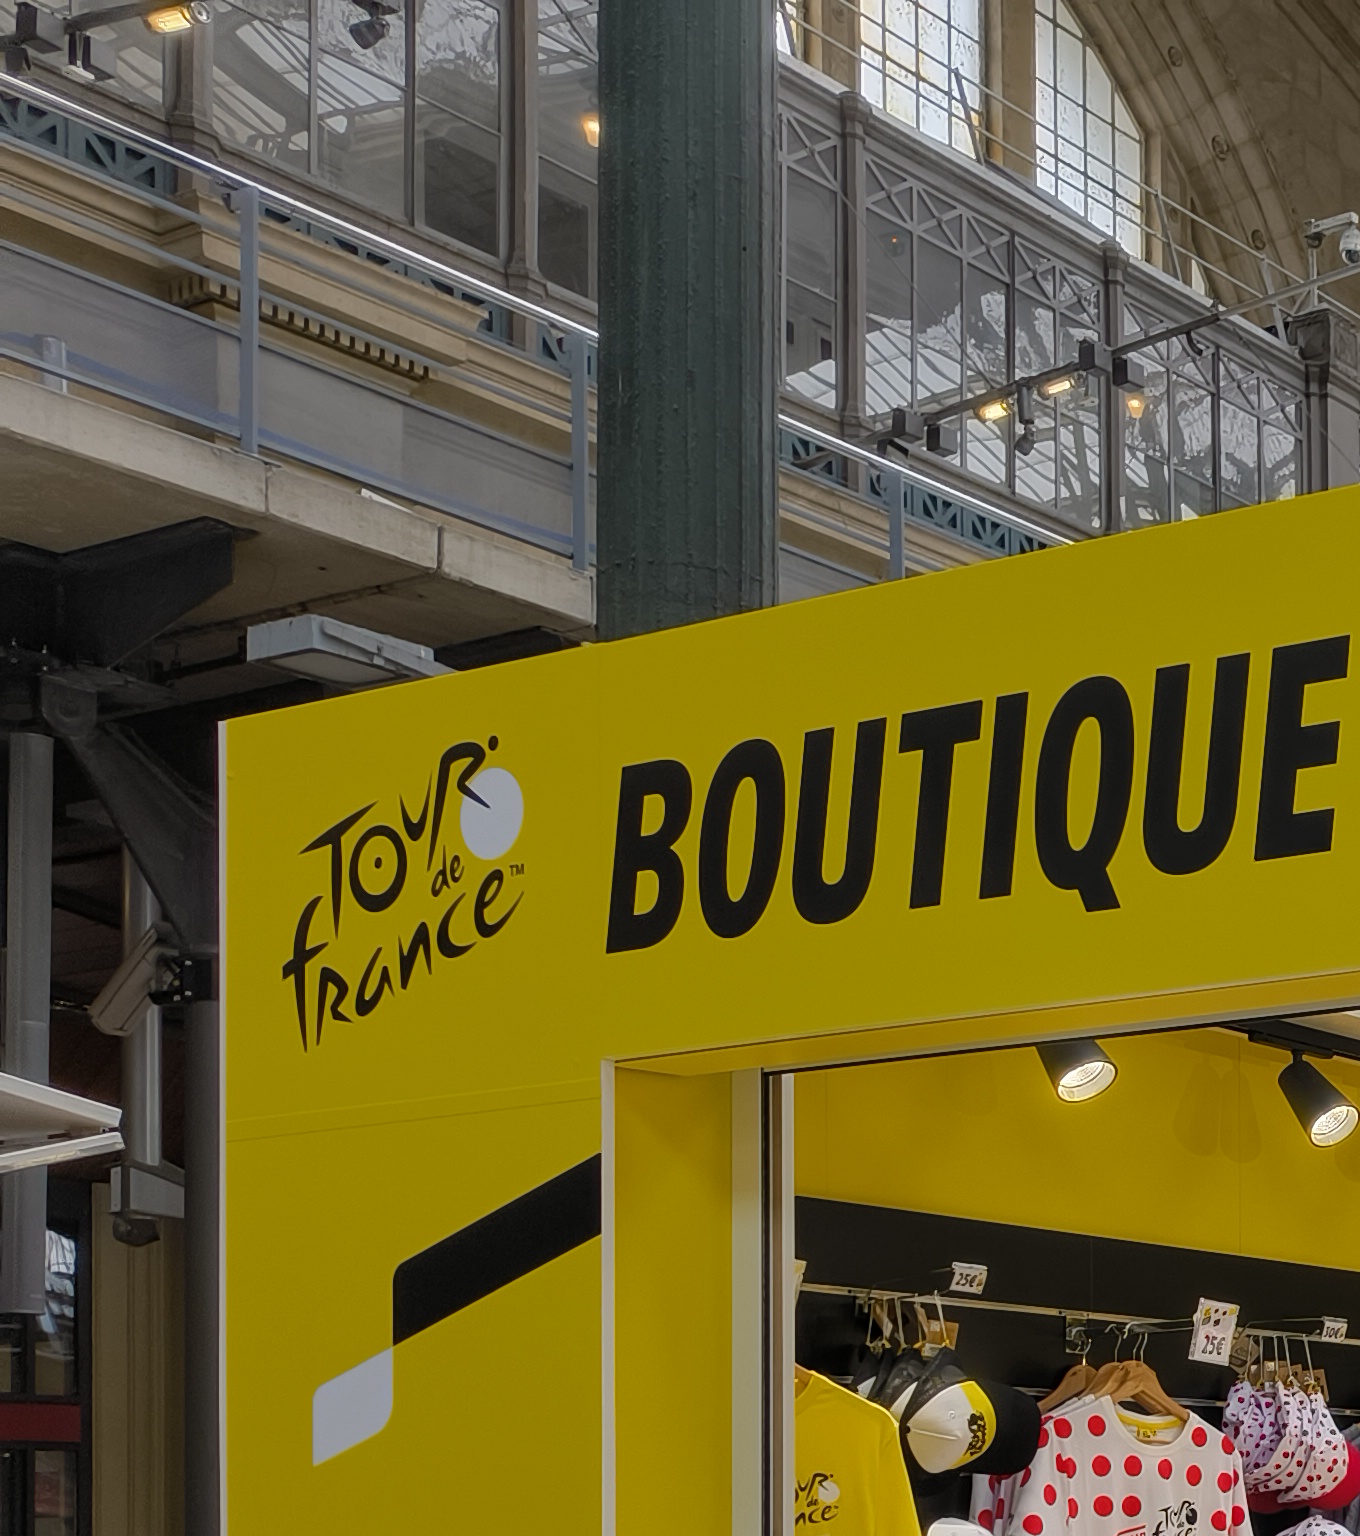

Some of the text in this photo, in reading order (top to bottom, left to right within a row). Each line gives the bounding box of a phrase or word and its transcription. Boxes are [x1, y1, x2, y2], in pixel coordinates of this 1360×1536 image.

[299, 735, 499, 939] TOUR
[605, 635, 1350, 953] BOUTIQUE
[431, 845, 464, 897] de
[282, 867, 524, 1053] france
[955, 1272, 978, 1288] 25€
[1201, 1334, 1226, 1356] 25€
